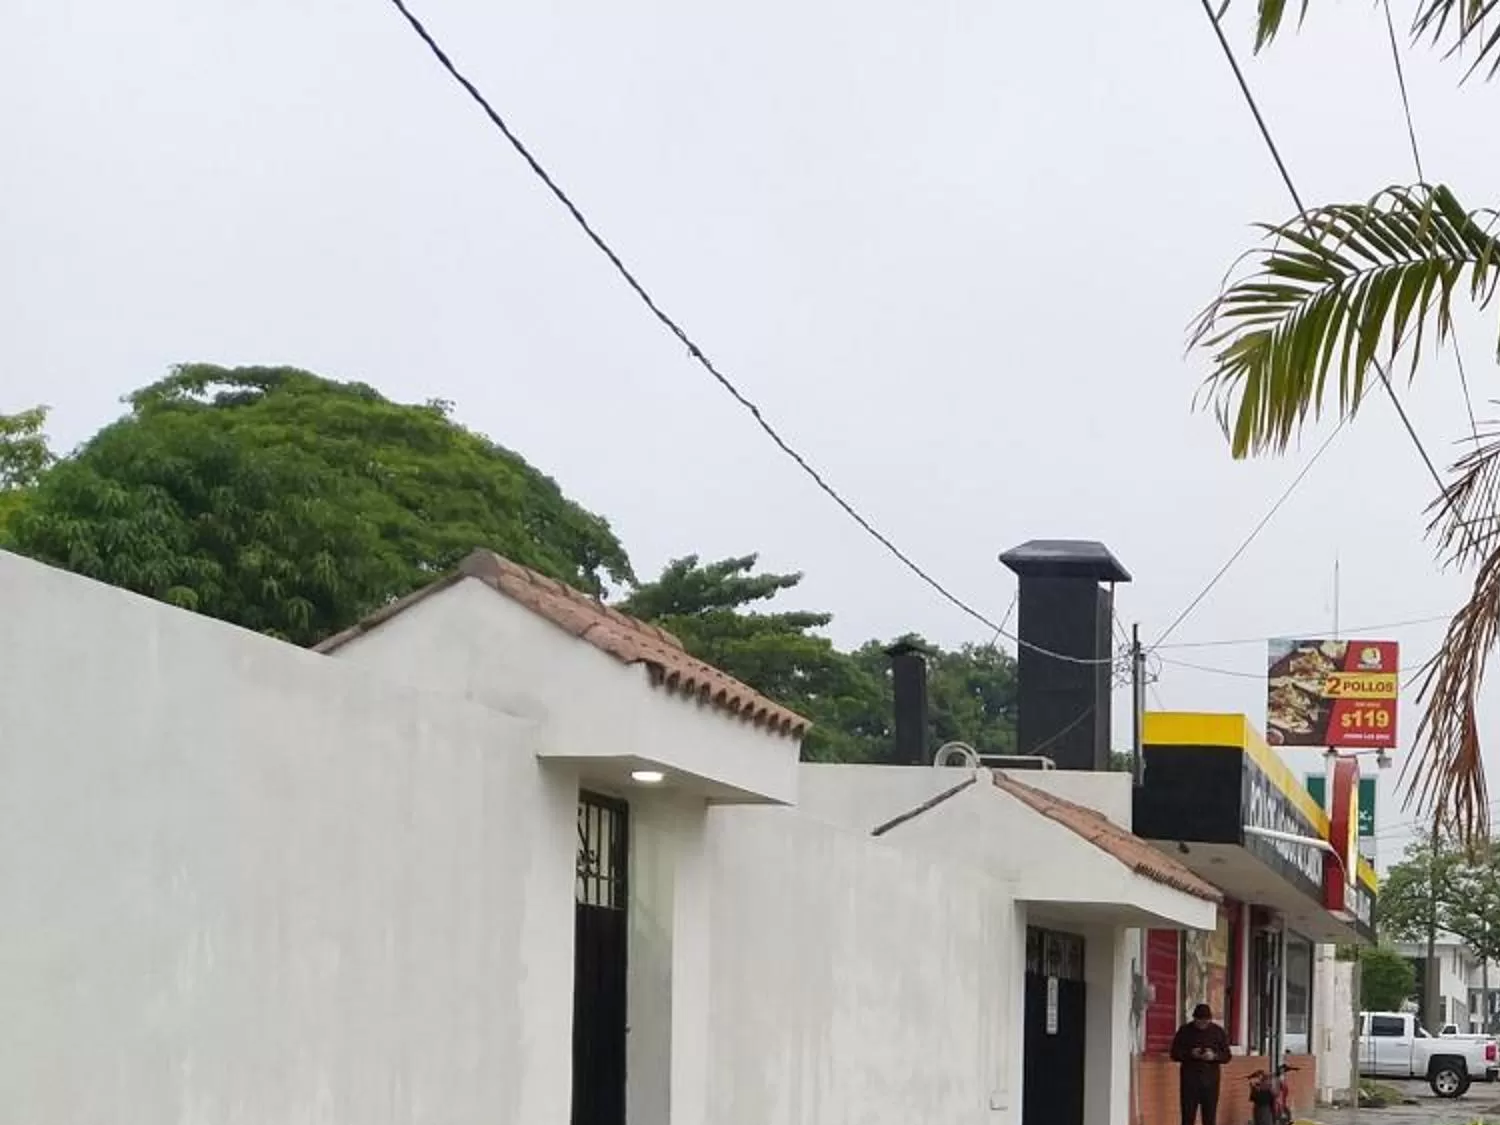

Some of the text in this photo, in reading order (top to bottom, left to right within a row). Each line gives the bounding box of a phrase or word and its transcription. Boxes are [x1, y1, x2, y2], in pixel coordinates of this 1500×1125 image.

[1327, 675, 1394, 695] 2 POLLOS
[1341, 709, 1389, 728] $119
